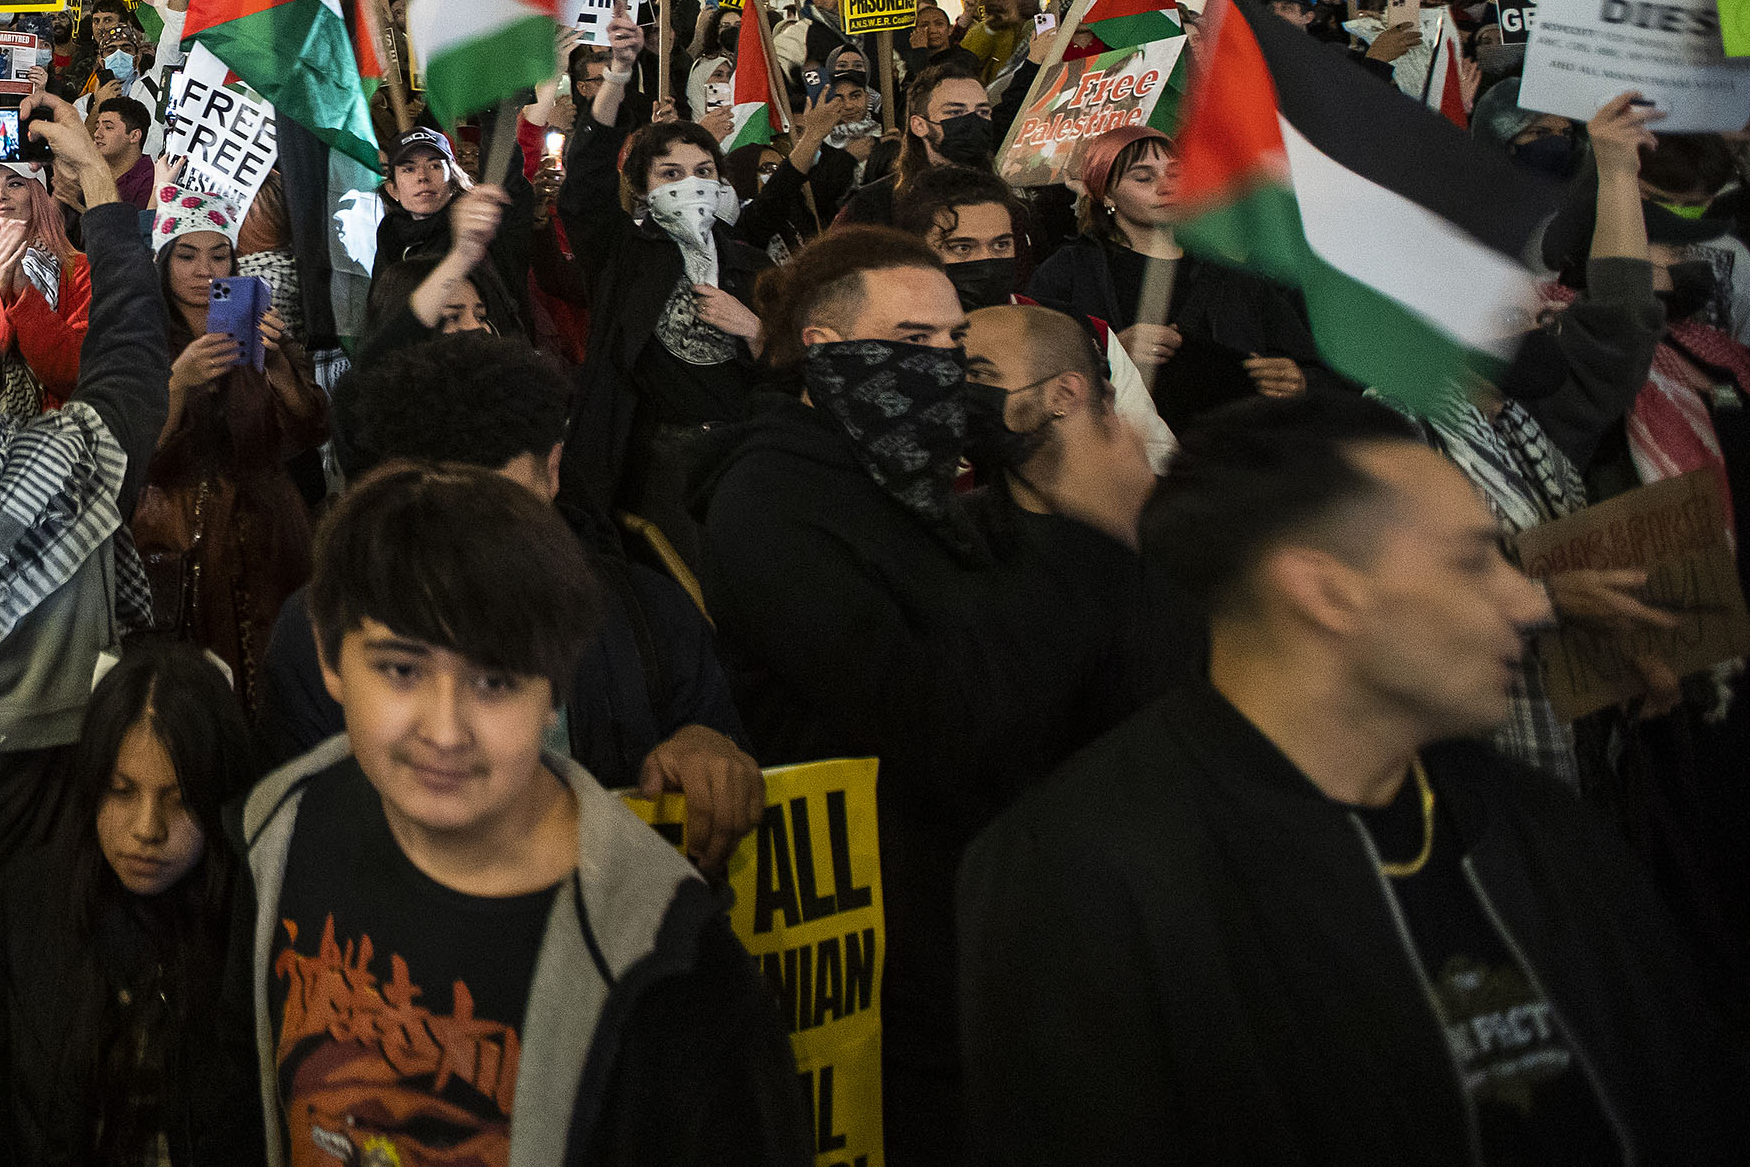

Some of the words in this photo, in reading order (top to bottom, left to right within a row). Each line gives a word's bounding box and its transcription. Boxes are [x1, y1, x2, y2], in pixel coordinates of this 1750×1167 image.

[850, 18, 892, 31] A.N.S.W.E.R.
[1067, 69, 1161, 110] Free
[179, 78, 277, 155] FREE
[401, 132, 437, 146] SOX
[1013, 104, 1143, 149] Palestine
[171, 114, 265, 188] FREE
[753, 791, 873, 934] ALL
